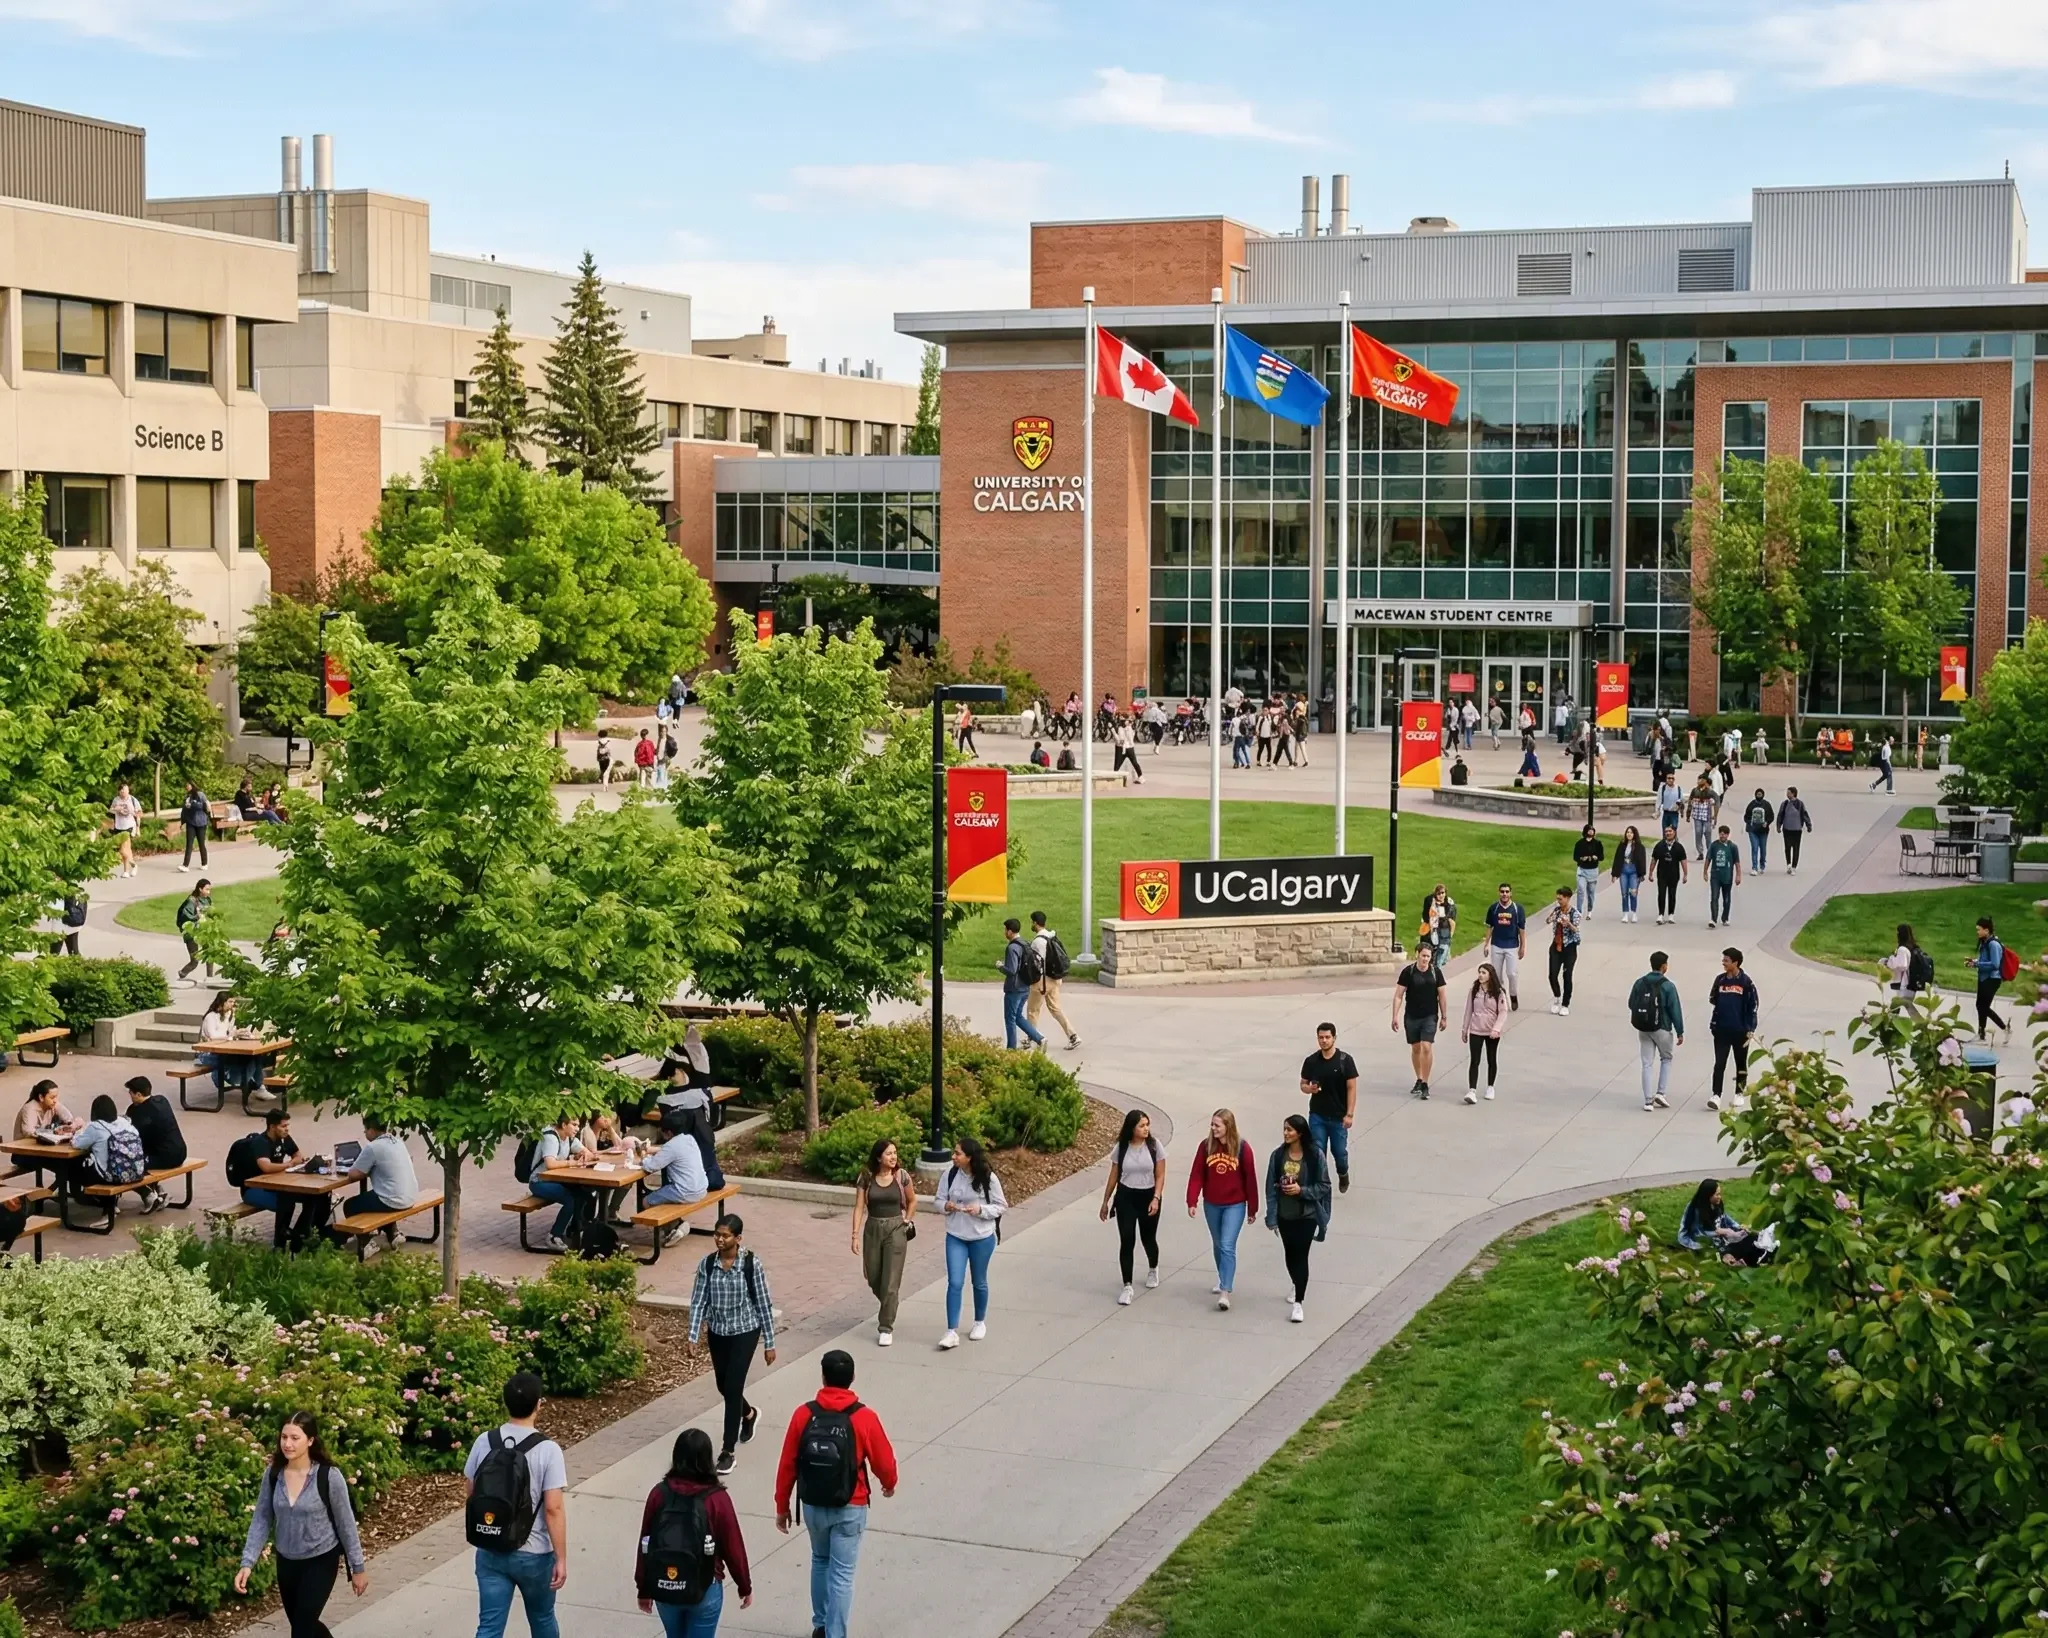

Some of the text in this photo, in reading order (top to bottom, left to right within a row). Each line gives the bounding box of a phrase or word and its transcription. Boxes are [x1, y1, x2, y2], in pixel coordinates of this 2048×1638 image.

[134, 424, 224, 451] Science B
[973, 476, 1067, 489] UNIVERSITY
[1354, 608, 1553, 622] MACEWAN STUDENT CENTRE
[1194, 868, 1360, 907] UCalgary
